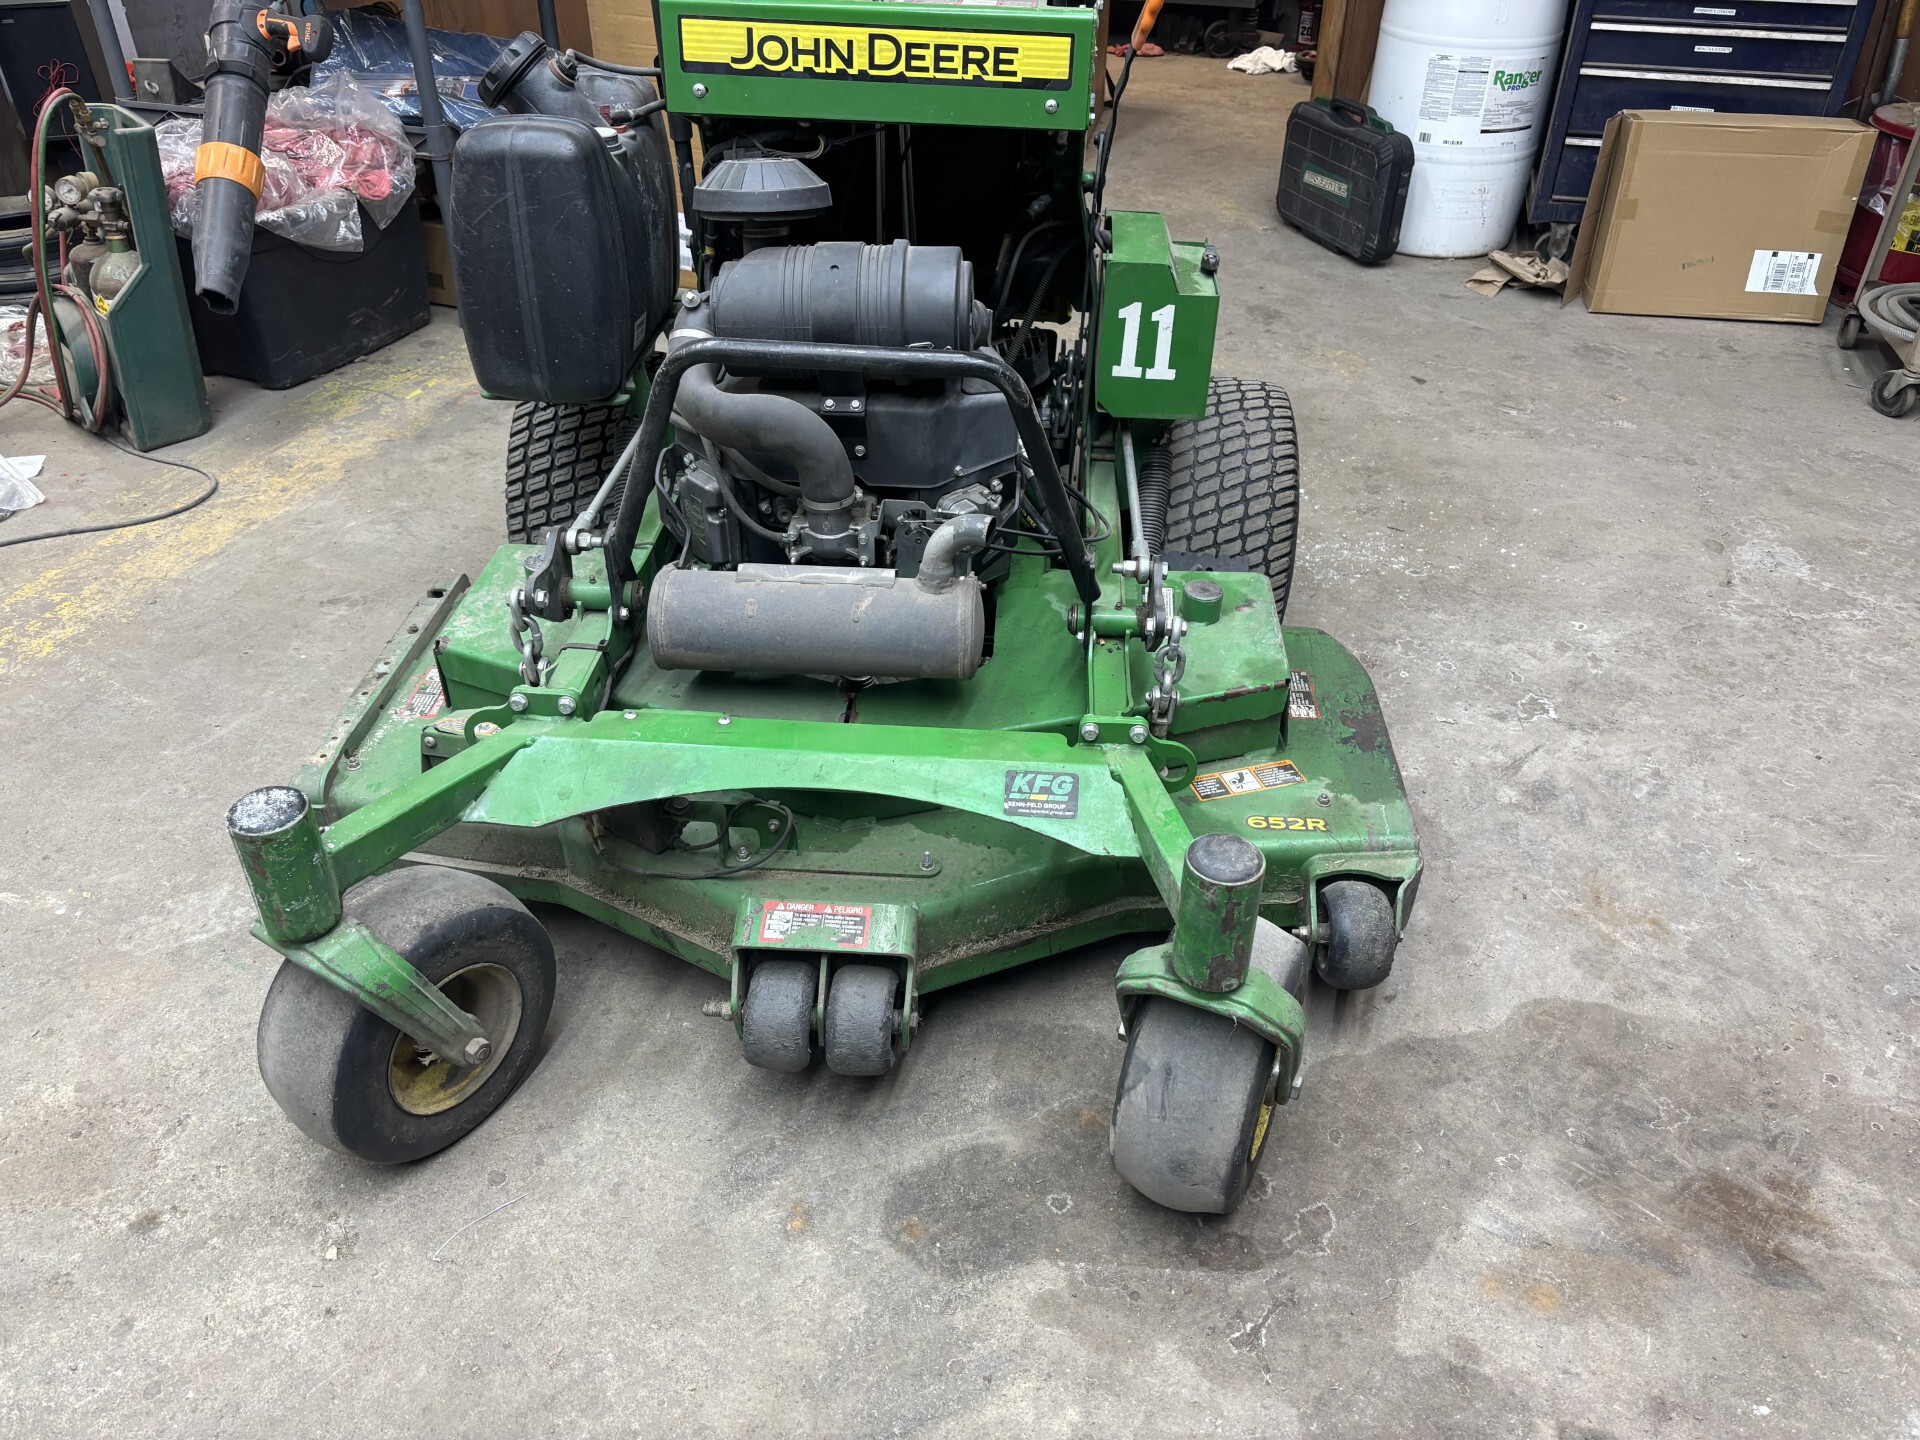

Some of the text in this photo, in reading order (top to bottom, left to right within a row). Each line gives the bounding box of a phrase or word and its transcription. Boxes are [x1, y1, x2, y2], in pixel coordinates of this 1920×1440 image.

[304, 22, 312, 43] STIHL
[730, 26, 1020, 78] JOHN DEERE
[1493, 70, 1543, 91] Ranger
[1111, 301, 1177, 381] 11
[1010, 773, 1074, 795] KFG
[1246, 815, 1328, 832] 652R
[786, 902, 815, 912] DANGER
[833, 905, 864, 915] PELIGRO
